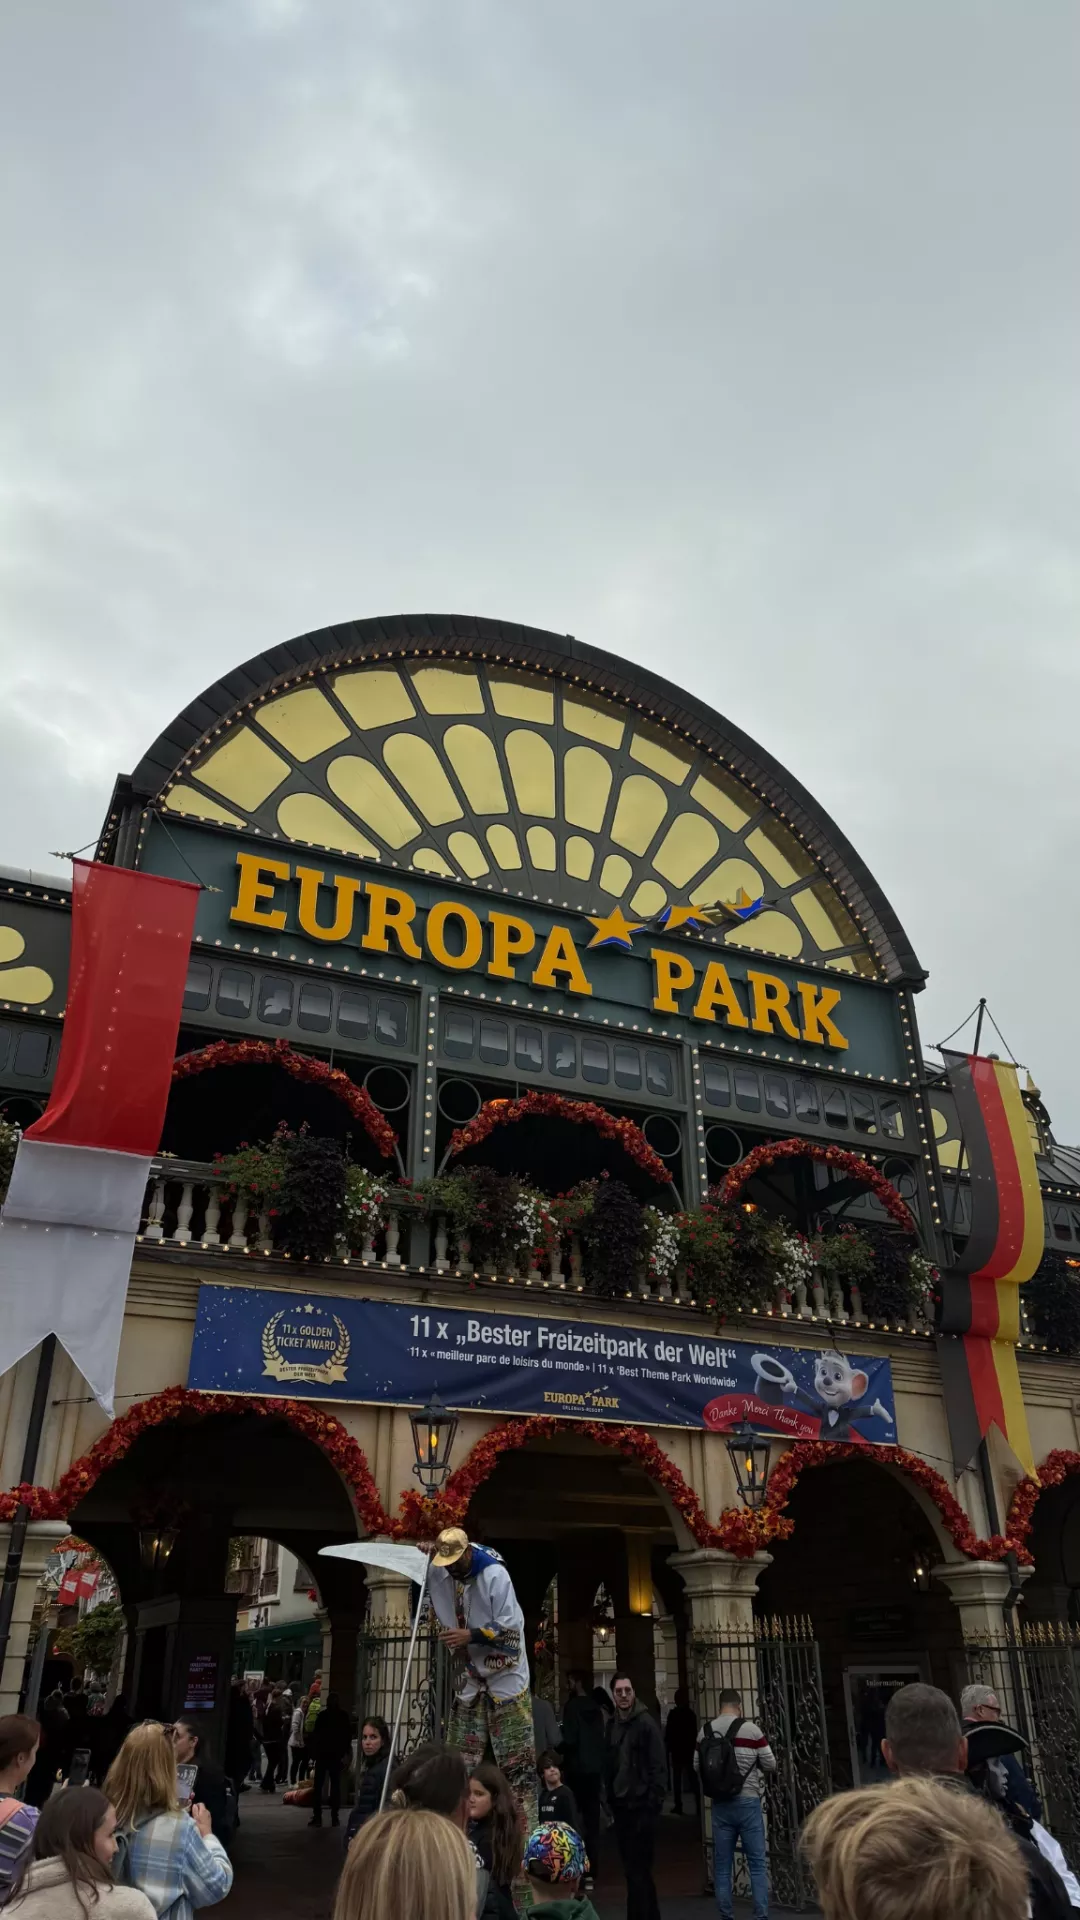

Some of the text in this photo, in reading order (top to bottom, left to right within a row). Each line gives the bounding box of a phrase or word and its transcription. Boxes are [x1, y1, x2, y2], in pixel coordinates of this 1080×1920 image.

[229, 851, 849, 1049] EUROPA PARK
[276, 1336, 337, 1351] TICKET AWARD
[299, 1325, 333, 1338] GOLDEN
[410, 1315, 430, 1338] 11
[436, 1322, 449, 1340] x
[537, 1327, 649, 1360] Freizeitpark
[654, 1341, 683, 1363] der
[410, 1347, 419, 1357] 11
[421, 1349, 428, 1358] x
[476, 1353, 497, 1365] parc
[499, 1354, 511, 1365] de
[512, 1355, 540, 1368] loisirs
[541, 1358, 553, 1369] du
[598, 1364, 607, 1374] 11
[609, 1367, 615, 1375] x
[641, 1368, 670, 1381] Theme
[672, 1372, 691, 1383] Park
[543, 1391, 620, 1409] EUROPA PARK
[709, 1399, 814, 1437] Danke Merci Thank you
[866, 1678, 905, 1687] Information
